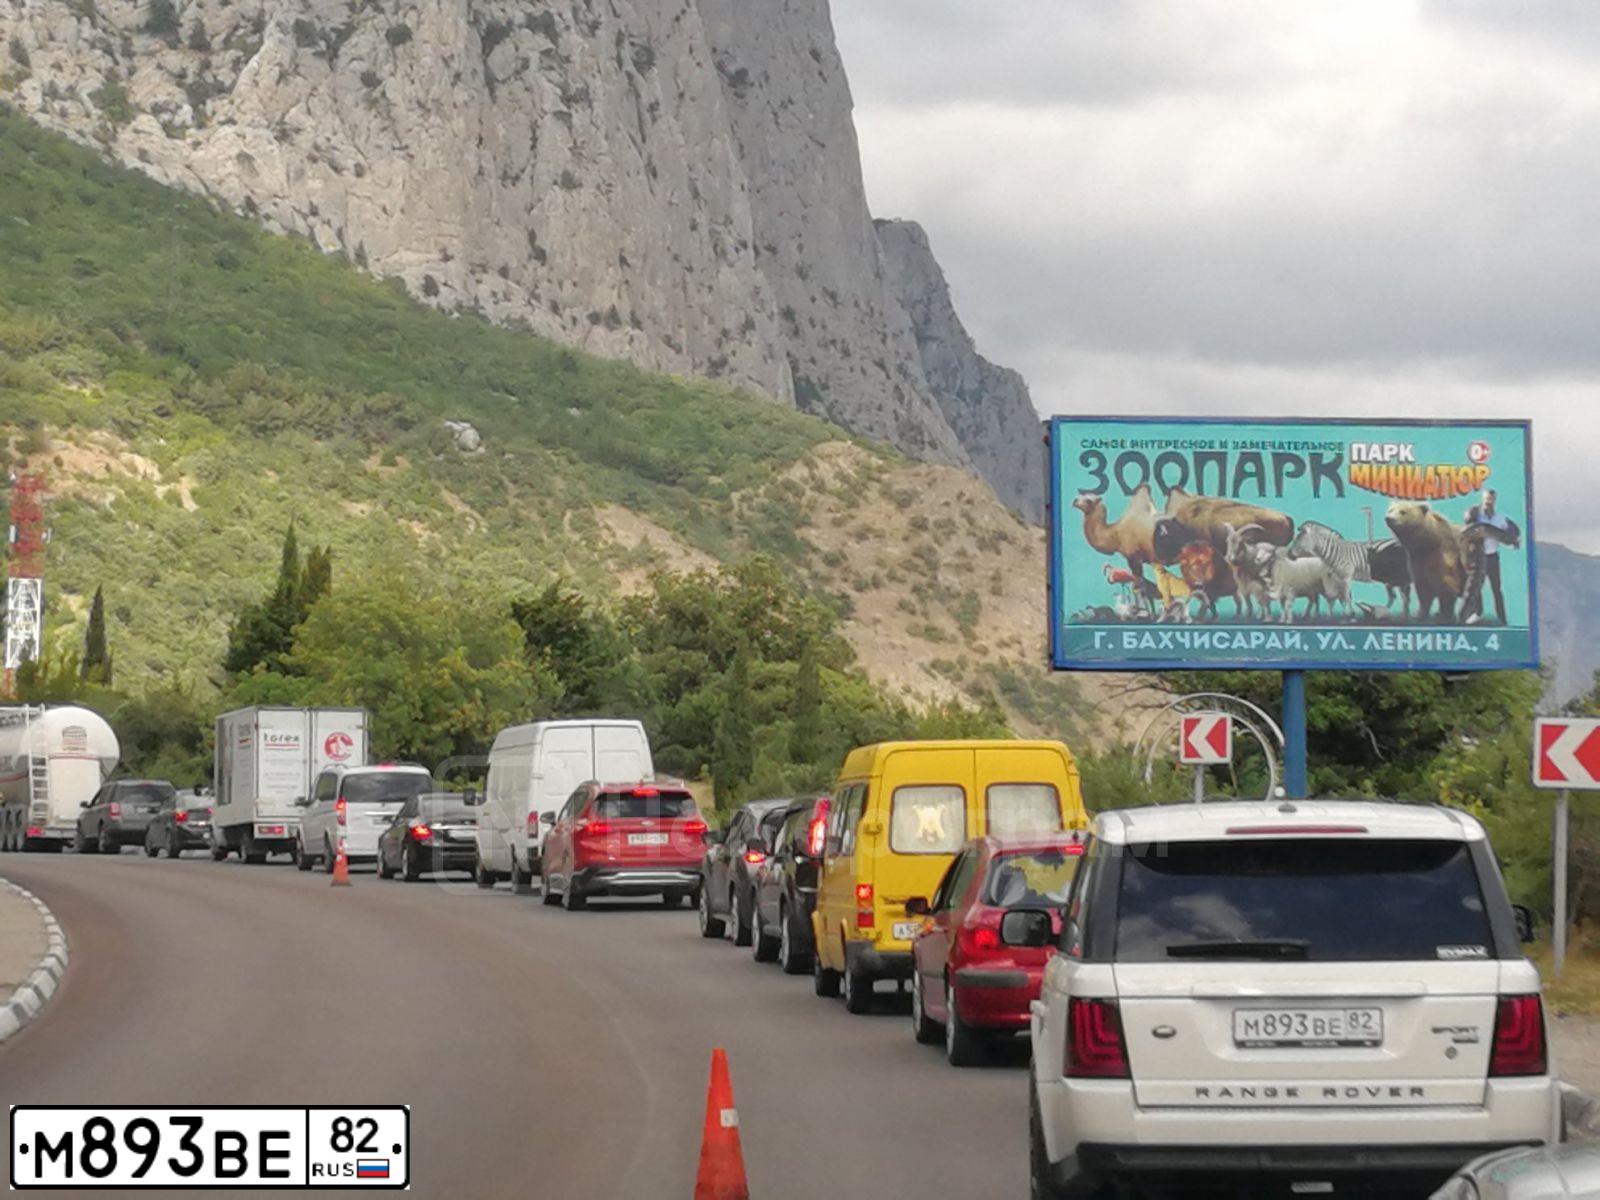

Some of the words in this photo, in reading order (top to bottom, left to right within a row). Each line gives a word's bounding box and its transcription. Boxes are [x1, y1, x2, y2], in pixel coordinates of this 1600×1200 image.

[1080, 439, 1127, 449] САМОЕ
[1130, 440, 1215, 450] ИНТЕРЕСНОЕ
[1219, 441, 1229, 450] И
[1232, 441, 1345, 452] ЗАМЕЧАТЕЛЬНОЕ
[1351, 442, 1415, 463] ПАРК
[1077, 450, 1346, 498] ЗООПАРК
[1349, 464, 1491, 500] МИНИАТЮР
[1094, 631, 1114, 649] Г.
[1122, 630, 1309, 651] БАХЧИСАРАЙ,
[1316, 632, 1356, 650] УЛ.
[1363, 632, 1478, 652] ЛЕНИНА,
[1484, 633, 1500, 651] 4
[1195, 1086, 1300, 1098] RANGE
[1322, 1086, 1425, 1098] ROVER
